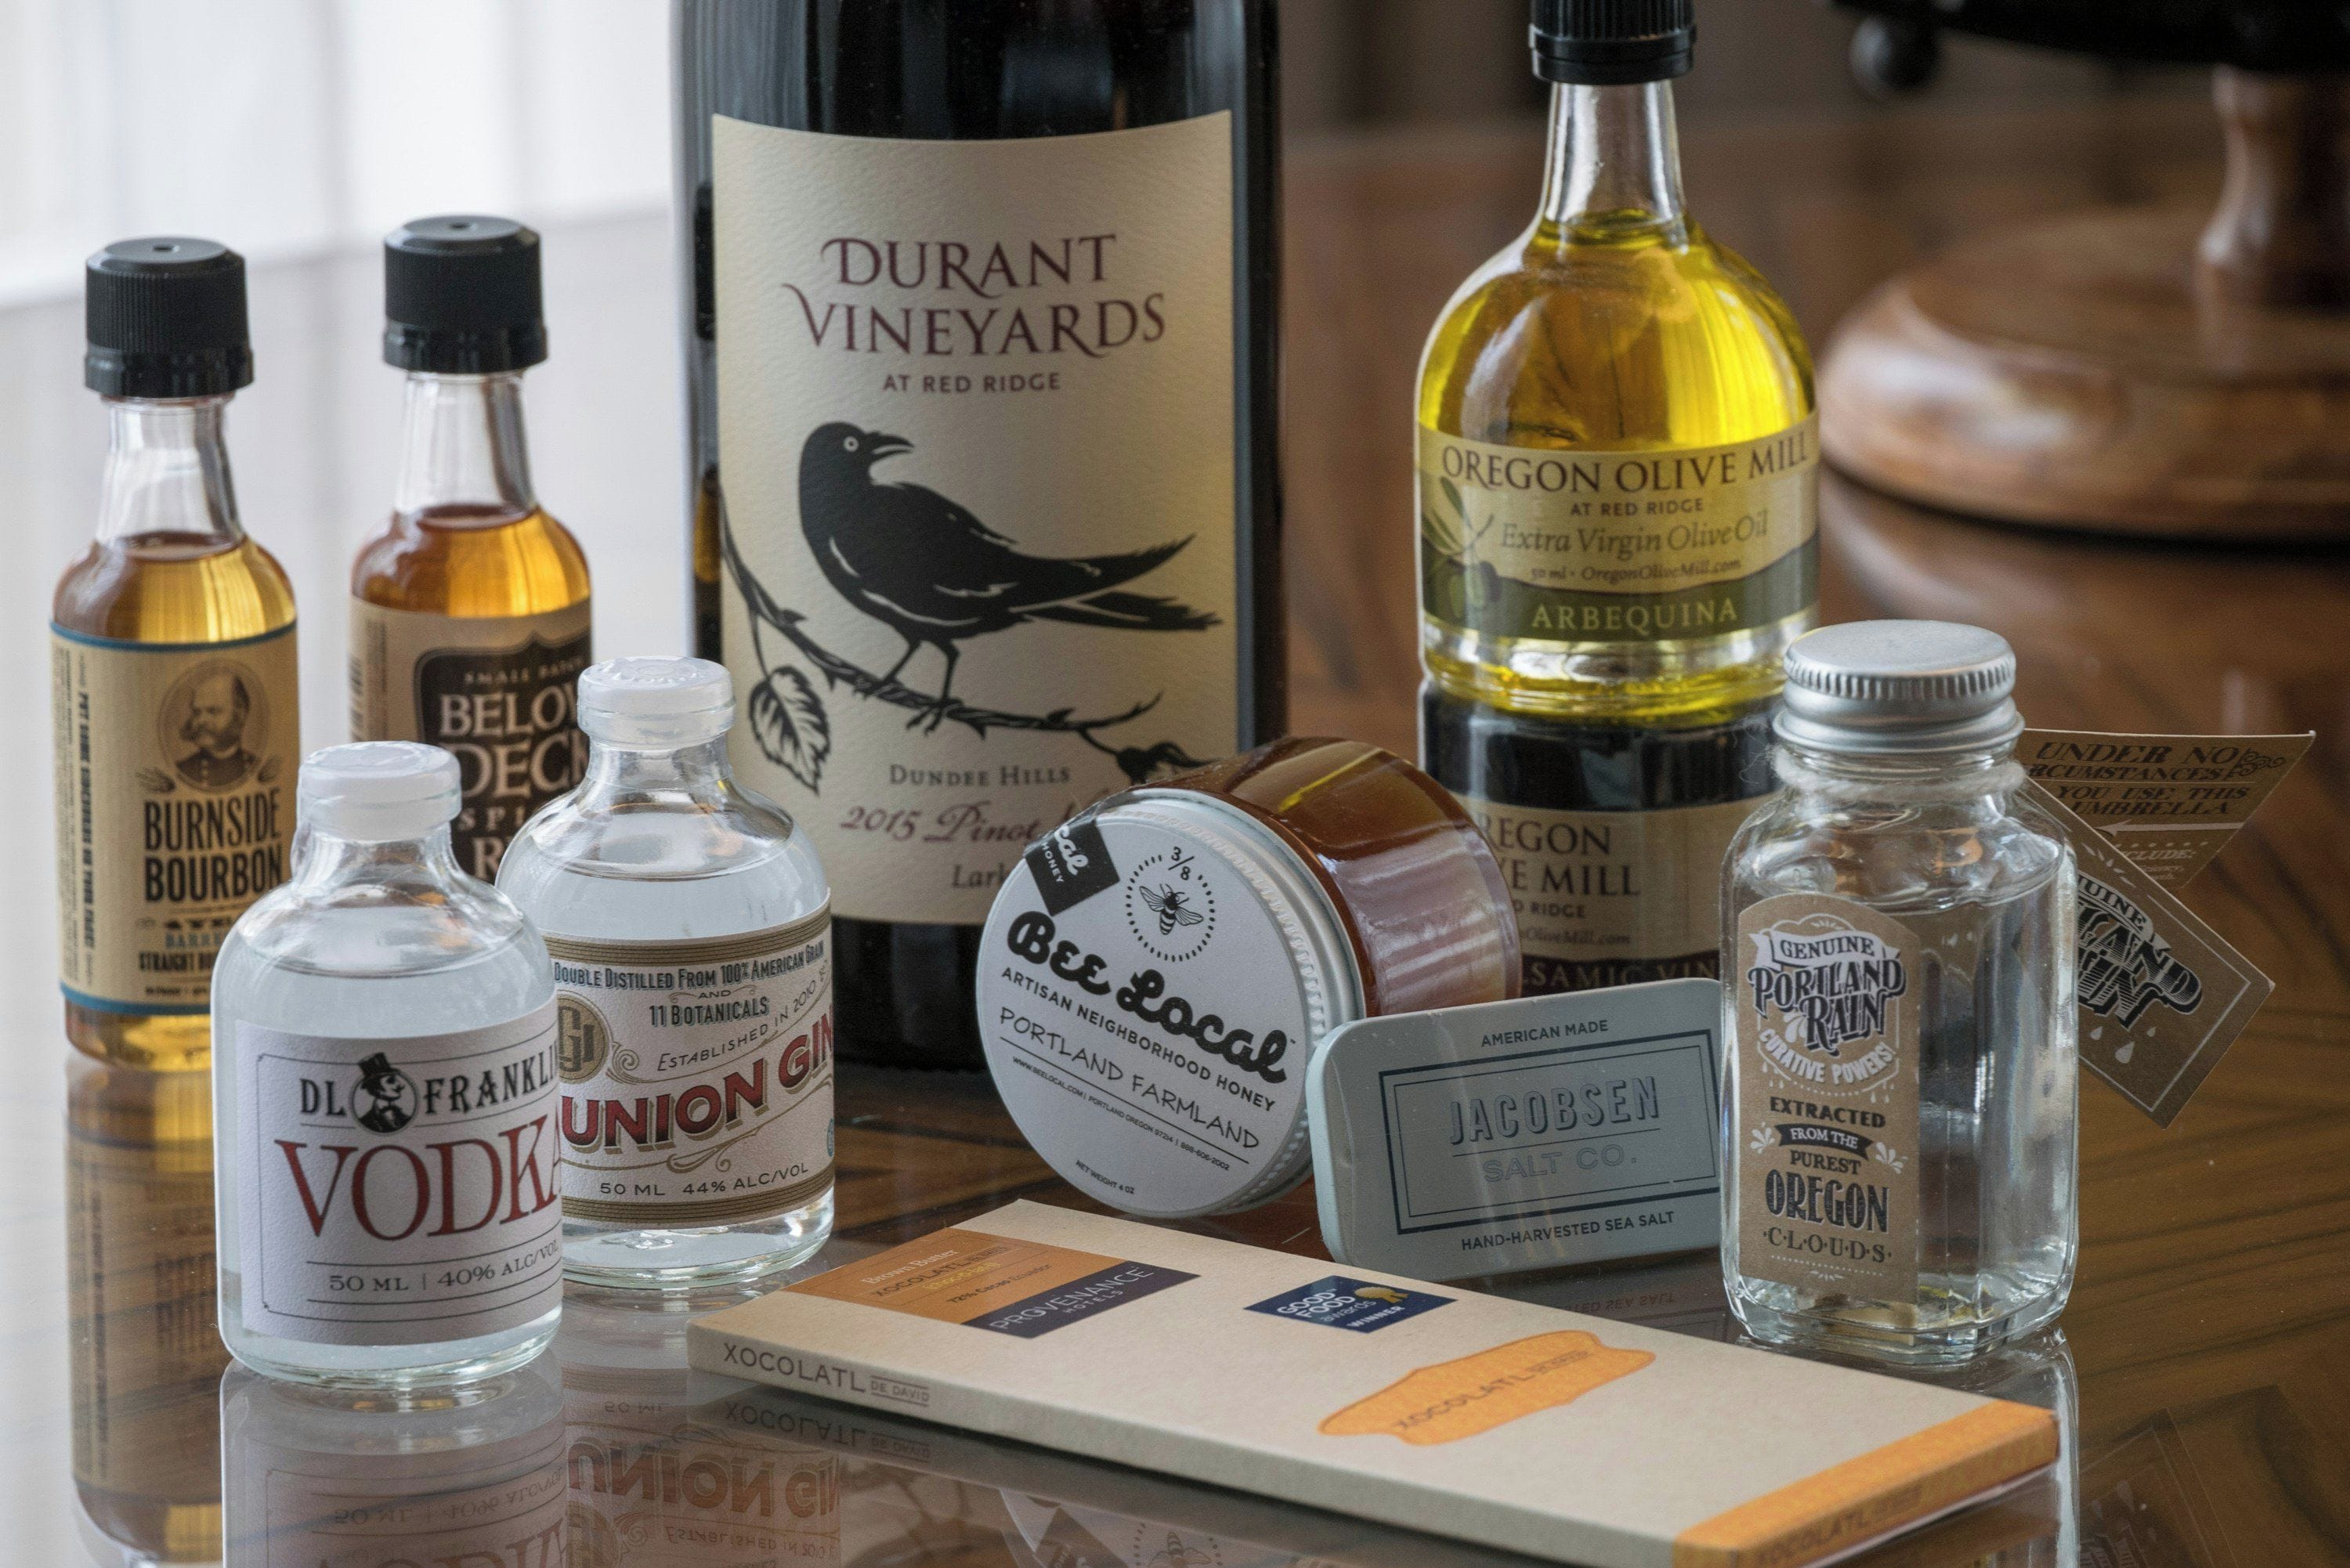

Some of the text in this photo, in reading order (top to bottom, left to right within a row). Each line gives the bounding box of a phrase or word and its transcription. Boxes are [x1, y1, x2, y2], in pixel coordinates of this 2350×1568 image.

[821, 234, 1116, 299] DURANT
[782, 284, 1165, 359] VINEYARDS
[883, 370, 1061, 393] AT RED RIDGE
[1441, 430, 1809, 493] OREGON OLIVE MILL
[1570, 497, 1704, 517] AT RED RIDGE
[1501, 509, 1769, 562] Extra Virgin Olive Oil
[1531, 597, 1737, 637] ARBEQUINA
[2036, 742, 2240, 764] UNDER NO
[889, 764, 1071, 787] DUNDEE HILLS
[2028, 763, 2227, 782] RCUMSTANCES
[2056, 786, 2251, 800] YOU USE THIS
[2070, 801, 2229, 815] UMBRELLA
[144, 787, 282, 851] BURNSIDE
[457, 805, 526, 832] SPI
[841, 805, 924, 843] 2015
[924, 800, 1042, 844] Pinot
[145, 842, 283, 903] BOURBON
[1541, 864, 1641, 897] MILL
[1529, 901, 1587, 919] RIDGE
[1779, 934, 1876, 960] GENUINE
[554, 961, 602, 988] DOUBLE
[605, 967, 674, 990] DISTILLED
[678, 968, 716, 989] FROM
[721, 962, 750, 986] 100%
[750, 950, 805, 981] AMERICAN
[1528, 962, 1643, 989] SAMIC
[1748, 957, 1907, 1018] PORTLAND
[649, 996, 772, 1028] 11 BOTANICALS
[697, 989, 732, 1000] AND
[656, 1024, 768, 1072] ESTABLISHED
[774, 1005, 789, 1028] IN
[1001, 966, 1276, 1113] ARTISAN NEIGHBORHOOD HONEY
[1481, 1019, 1609, 1048] AMERICAN MADE
[1801, 988, 1889, 1057] RAIN
[1759, 1028, 1827, 1084] CURATIVE
[1000, 1006, 1260, 1150] PORTLAND FARMLAND
[299, 1078, 345, 1117] DL
[561, 1057, 770, 1154] UNION
[1087, 1096, 1125, 1118] PORTLAND
[1125, 1113, 1155, 1133] OREGON
[1448, 1075, 1660, 1146] JACOBSEN
[1770, 1096, 1886, 1129] EXTRACTED
[1789, 1126, 1859, 1150] FROM THE
[599, 1161, 809, 1197] 50 ML 44% ALC/VOL
[1483, 1143, 1637, 1183] SALT CO.
[1789, 1149, 1861, 1176] PUREST
[1765, 1168, 1889, 1234] OREGON
[1461, 1211, 1675, 1252] HAND-HARVESTED SEA SALT
[329, 1274, 364, 1292] 50
[372, 1274, 409, 1292] ML
[436, 1263, 495, 1288] 40%
[862, 1260, 916, 1285] Brown
[910, 1248, 958, 1268] Butter
[989, 1267, 1155, 1330] PROVENANCE
[1062, 1290, 1124, 1314] HOTELS
[1276, 1292, 1336, 1314] GOOD
[1296, 1295, 1356, 1318] FOOD
[1320, 1299, 1377, 1323] awards
[1347, 1305, 1406, 1328] WINNER
[723, 1342, 930, 1402] XOCOLATL DE DAVID
